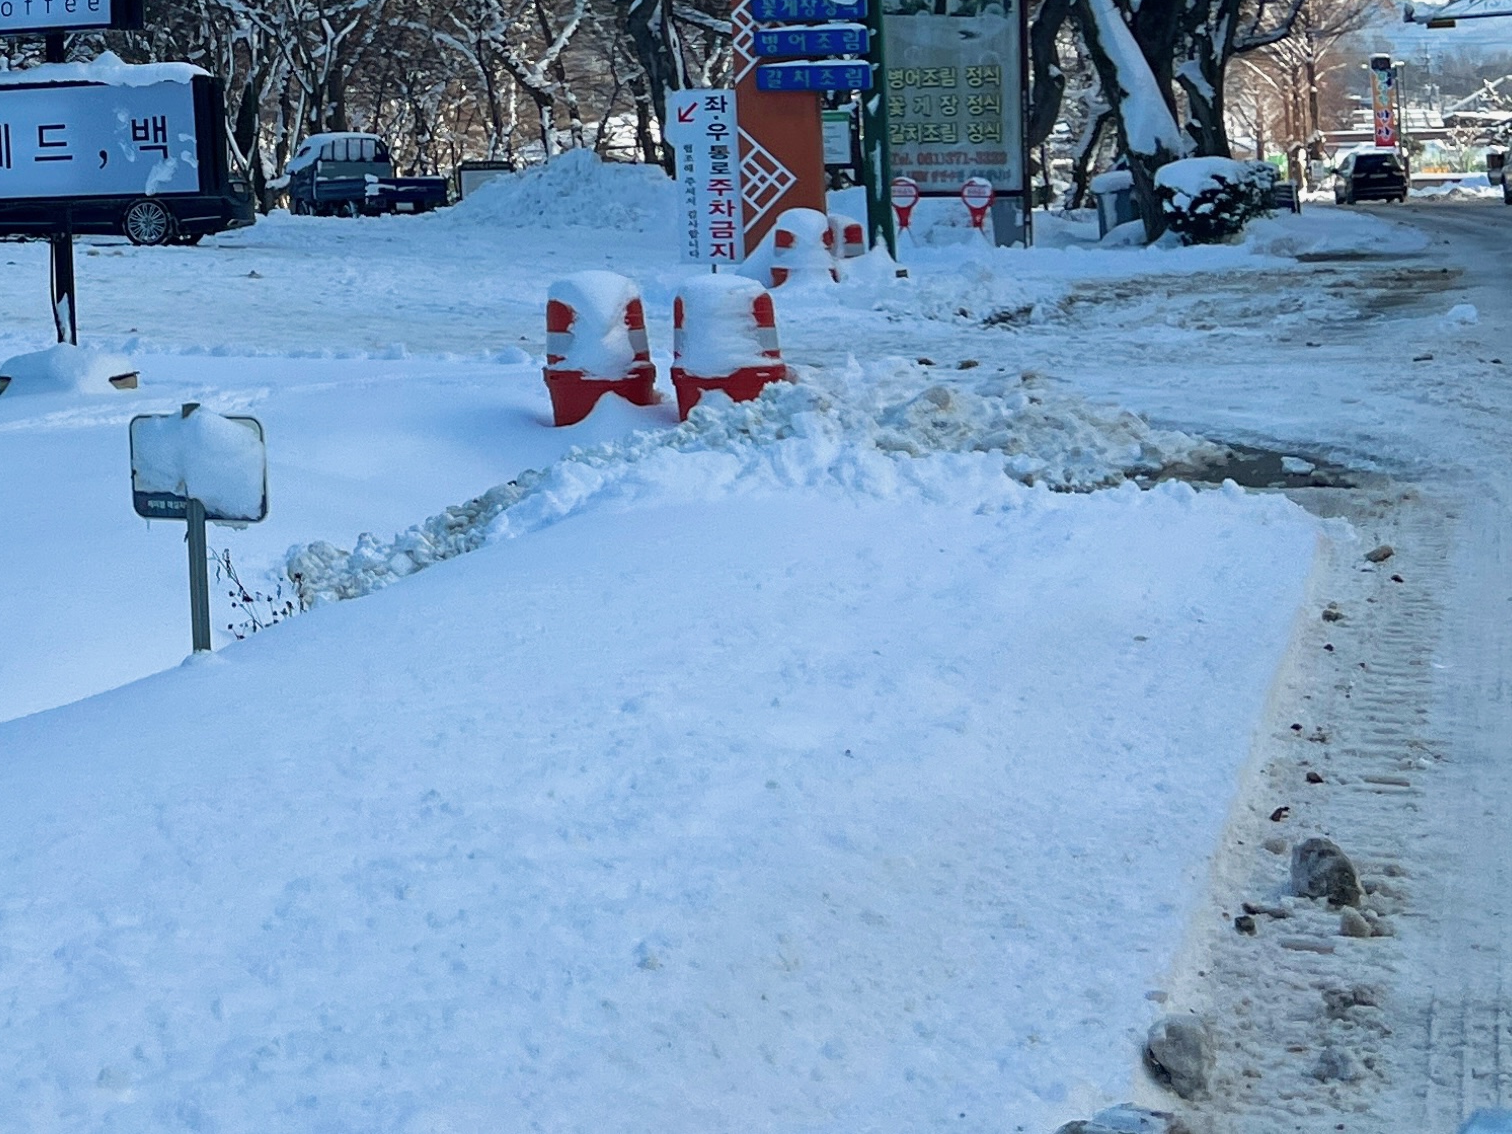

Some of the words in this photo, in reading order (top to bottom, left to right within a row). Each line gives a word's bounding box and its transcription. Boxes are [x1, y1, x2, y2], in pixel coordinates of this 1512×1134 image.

[761, 32, 860, 54] 병어조림
[766, 68, 863, 89] 갈치조림
[888, 66, 957, 89] 병어조림
[966, 65, 1001, 88] 정식
[966, 93, 1001, 116] 정식
[889, 123, 958, 144] 갈치조림
[966, 122, 1001, 144] 정식
